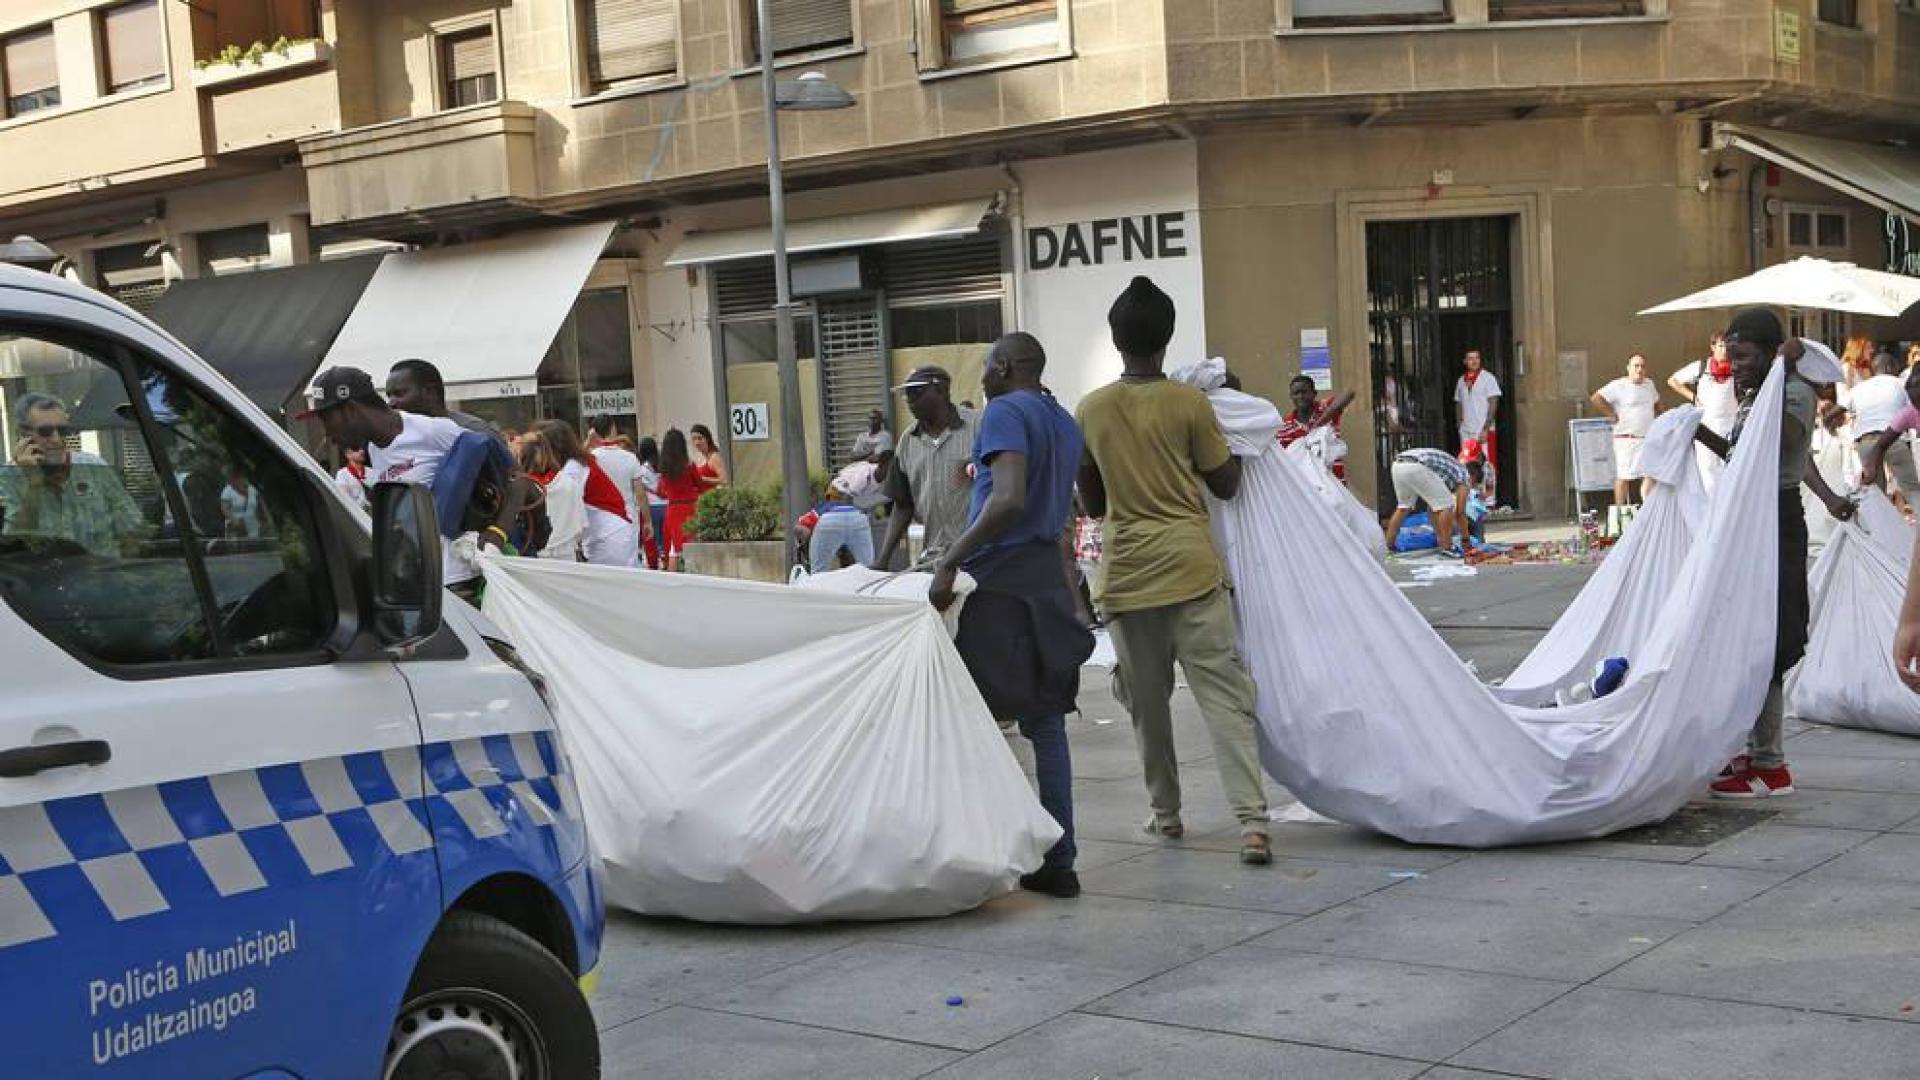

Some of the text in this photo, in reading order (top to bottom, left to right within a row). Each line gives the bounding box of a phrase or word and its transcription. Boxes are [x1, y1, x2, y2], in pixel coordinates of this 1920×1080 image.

[1029, 211, 1187, 270] DAFNE
[583, 392, 635, 412] Rebajas
[186, 919, 296, 984] Municipal
[92, 986, 255, 1065] Udaltzaingoa
